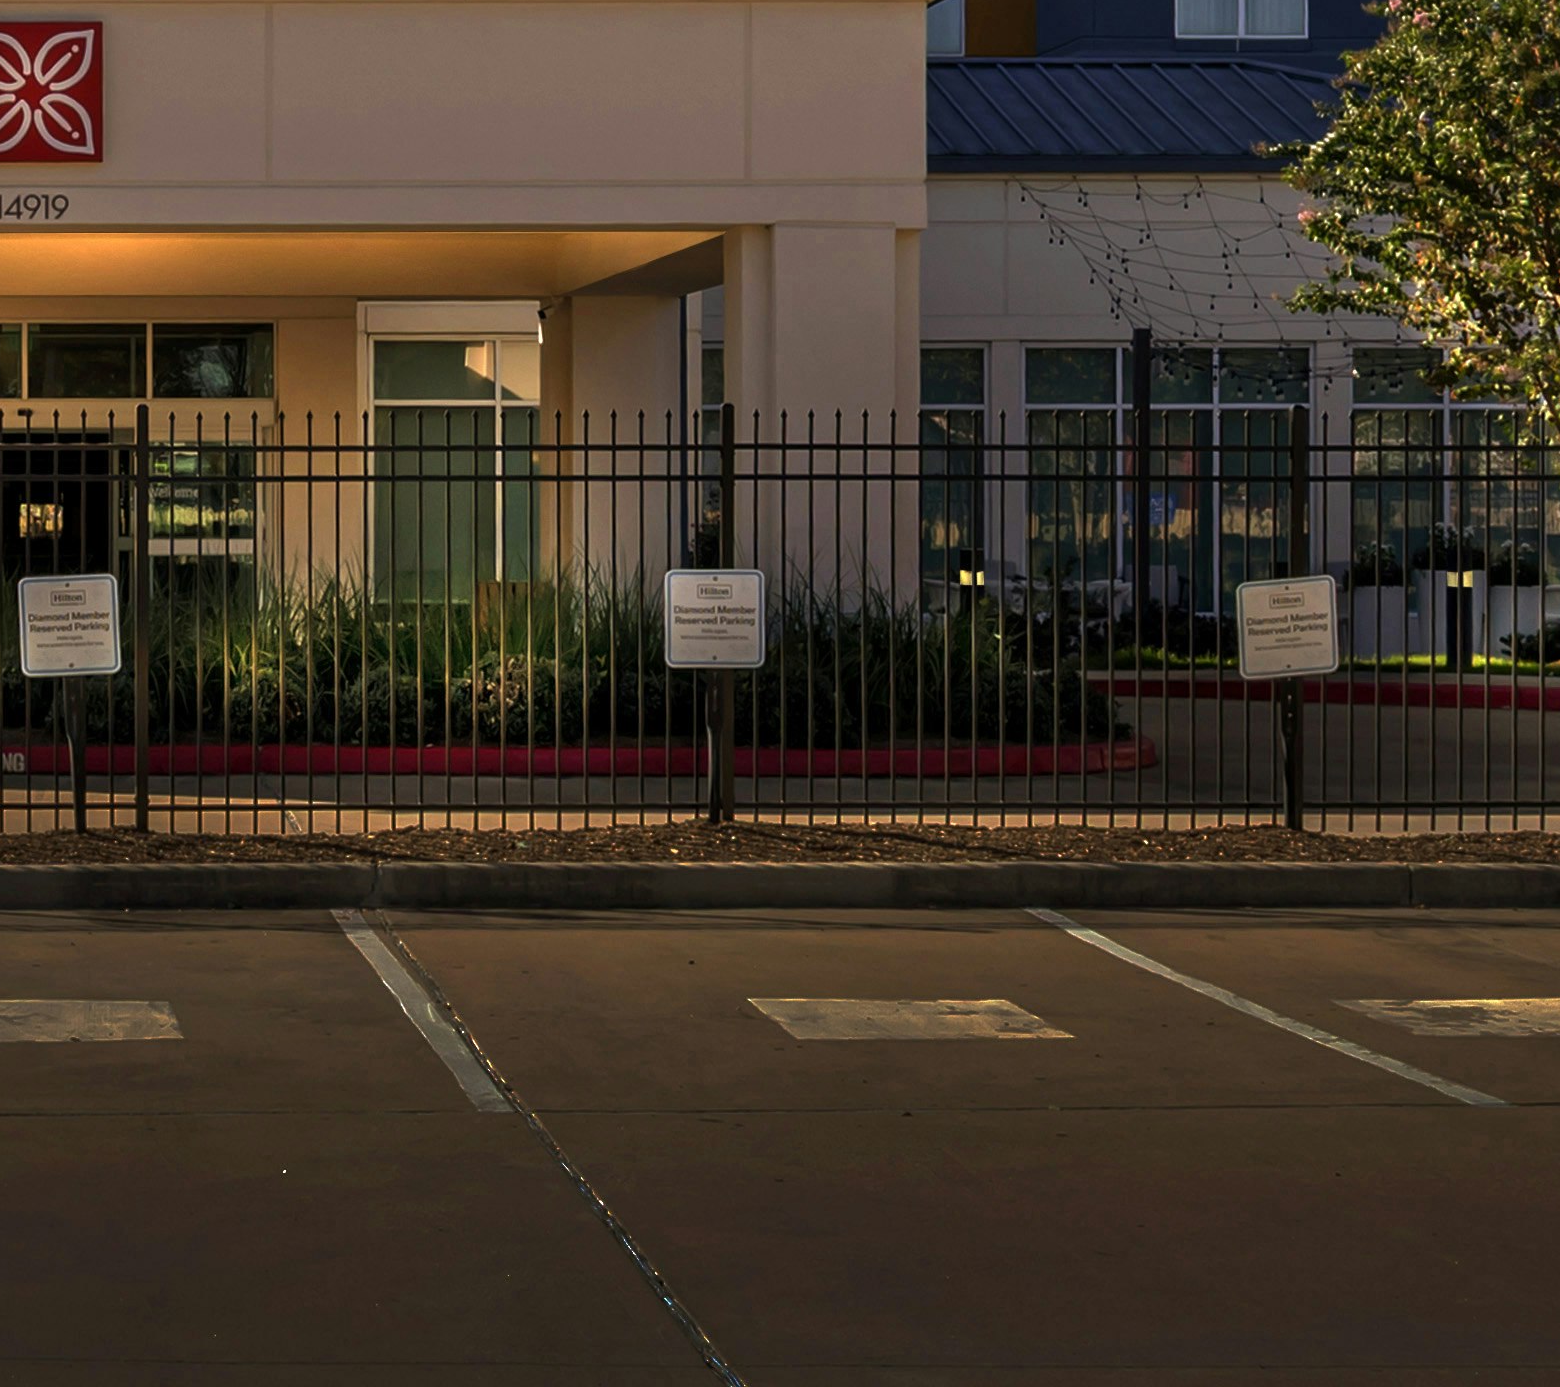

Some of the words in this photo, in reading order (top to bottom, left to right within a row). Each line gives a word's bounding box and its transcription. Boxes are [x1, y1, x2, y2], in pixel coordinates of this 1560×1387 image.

[700, 587, 729, 595] Hilton
[54, 594, 82, 602] Hilton
[674, 606, 715, 614] Diamond
[717, 606, 756, 614] Member
[28, 613, 69, 622] Diamond
[72, 611, 110, 621] Member
[1246, 616, 1288, 626] Diamond
[1290, 613, 1328, 622] Member
[720, 617, 755, 626] Parking
[30, 623, 72, 632] Reserved
[75, 622, 109, 632] Parking
[1248, 626, 1291, 636] Reserved
[1293, 623, 1328, 633] Parking
